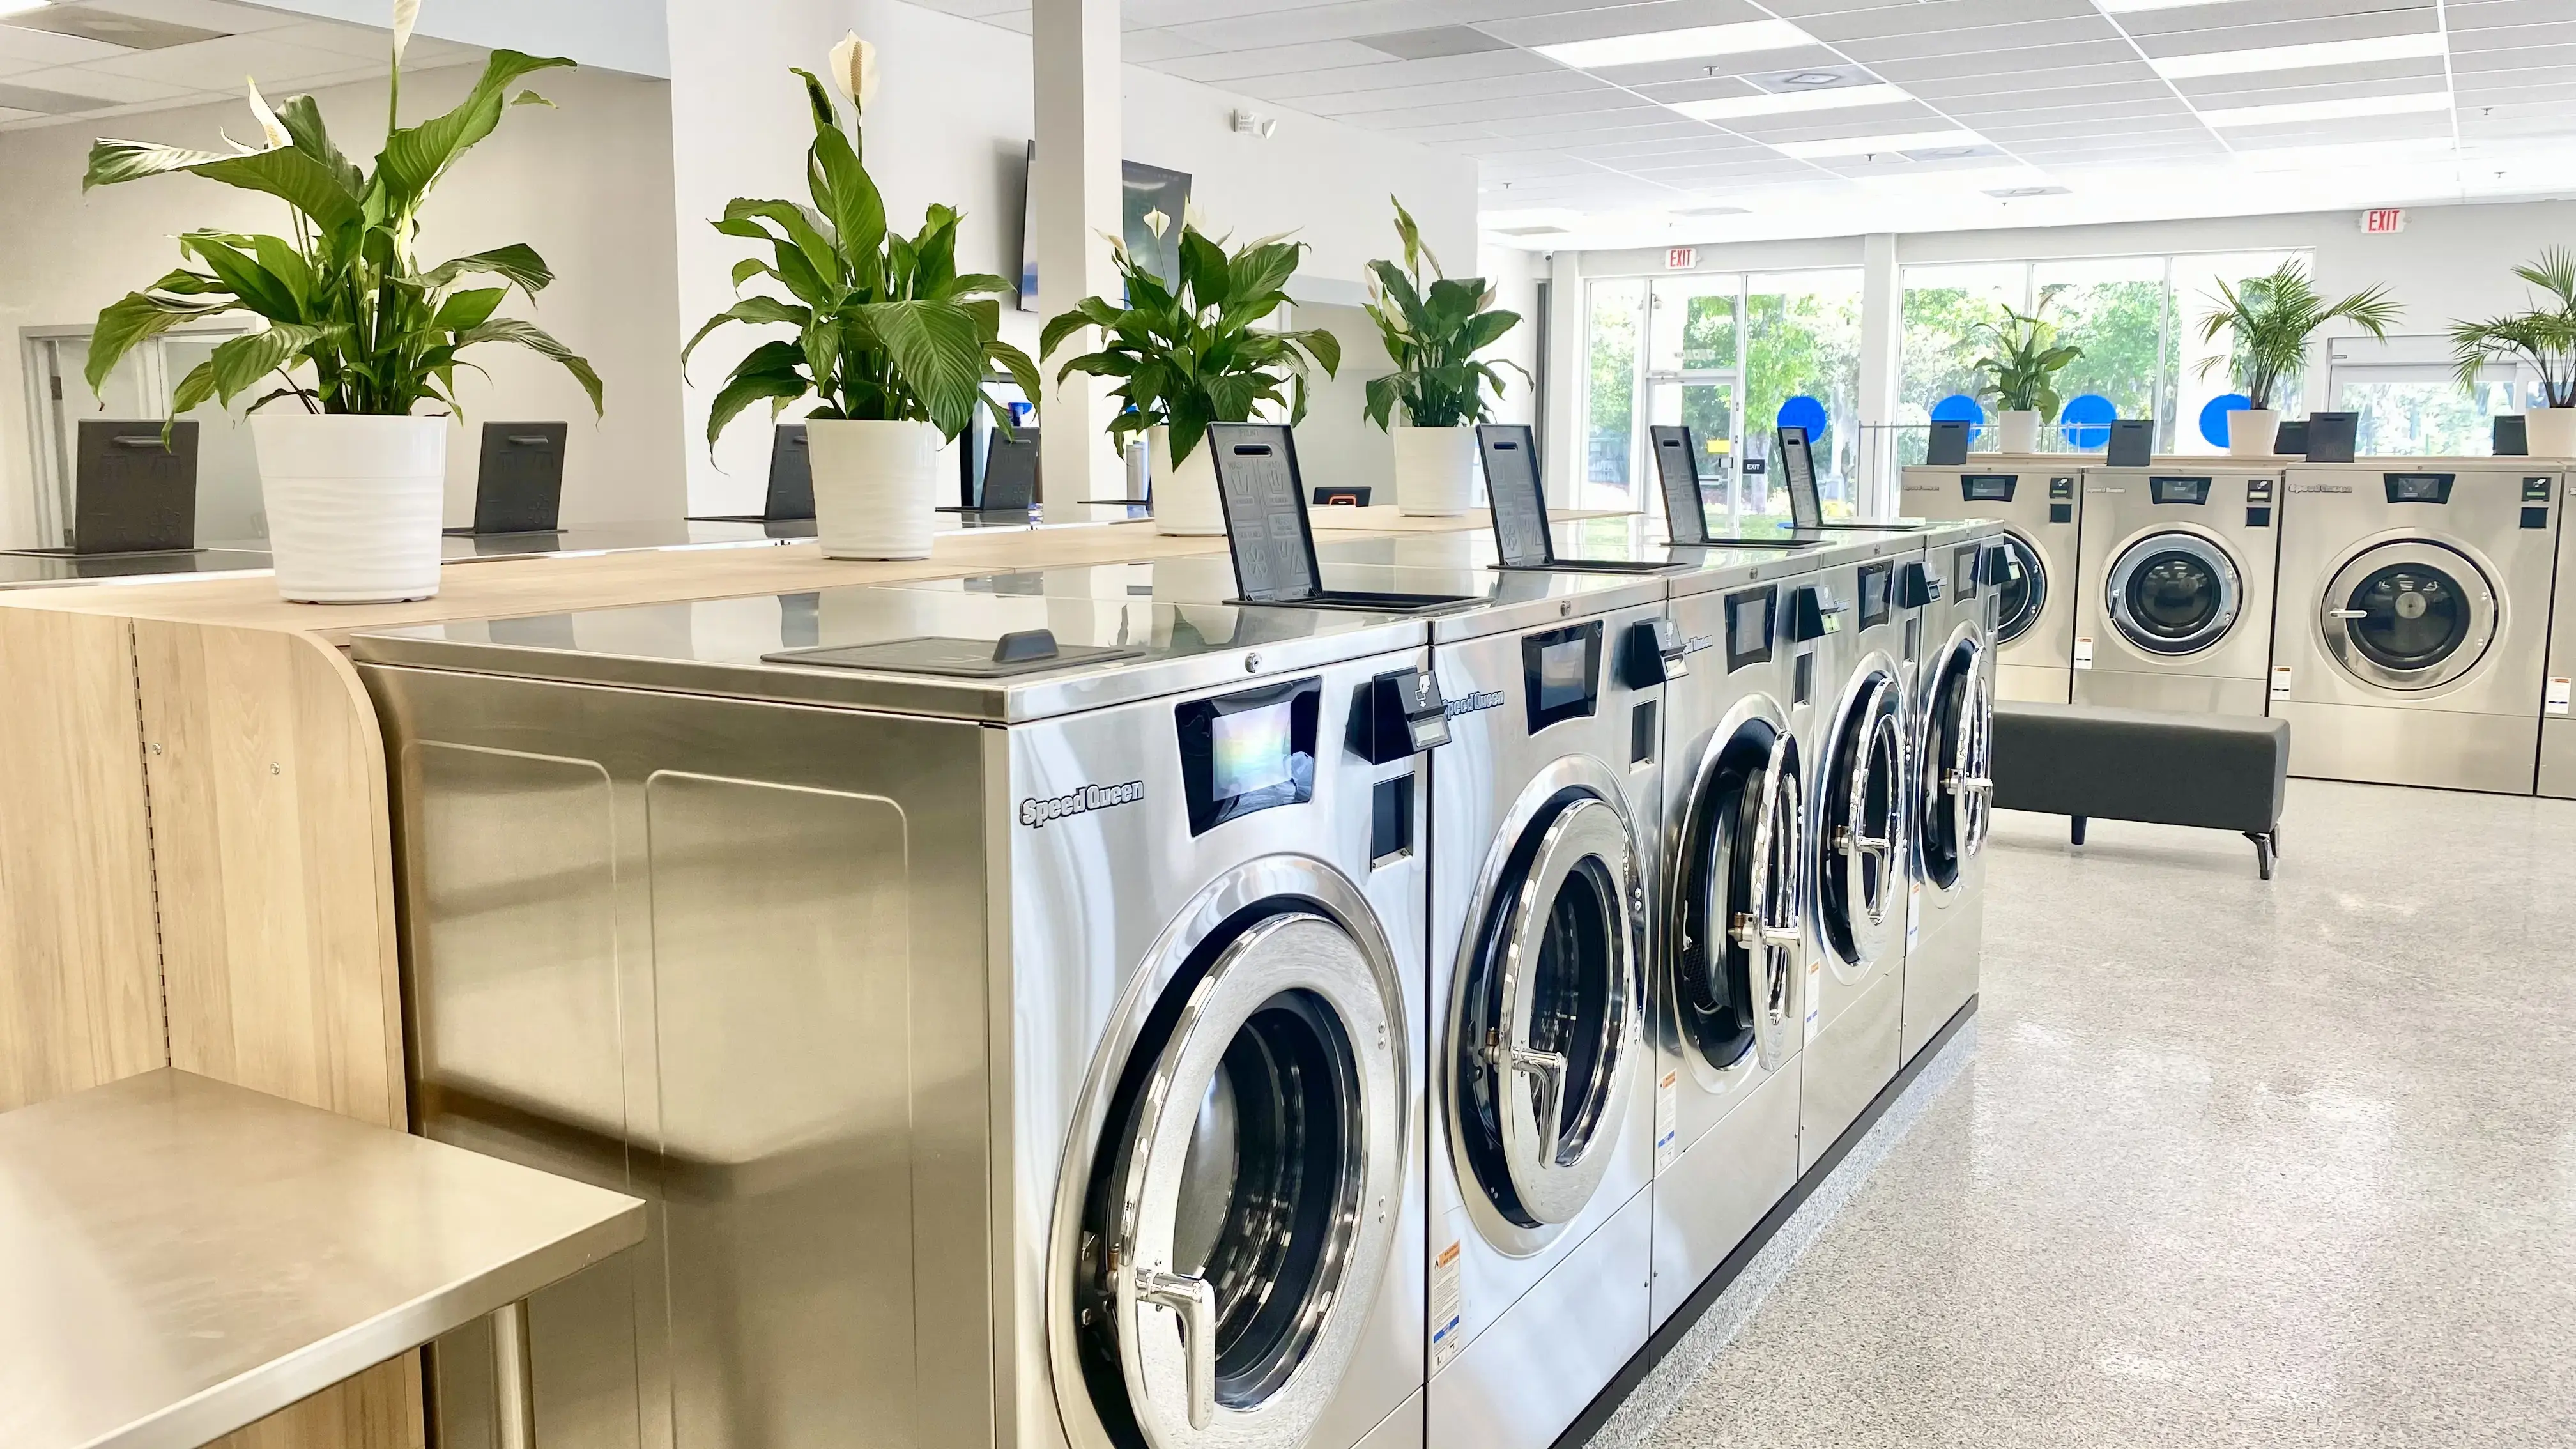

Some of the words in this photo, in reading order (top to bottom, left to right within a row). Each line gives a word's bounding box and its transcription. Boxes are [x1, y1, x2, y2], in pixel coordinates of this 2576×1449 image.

[2369, 210, 2400, 231] EXIT
[1670, 249, 1692, 267] EXIT
[1473, 690, 1505, 712] Queen
[1020, 787, 1085, 829] Speed
[1086, 780, 1144, 810] Queen
